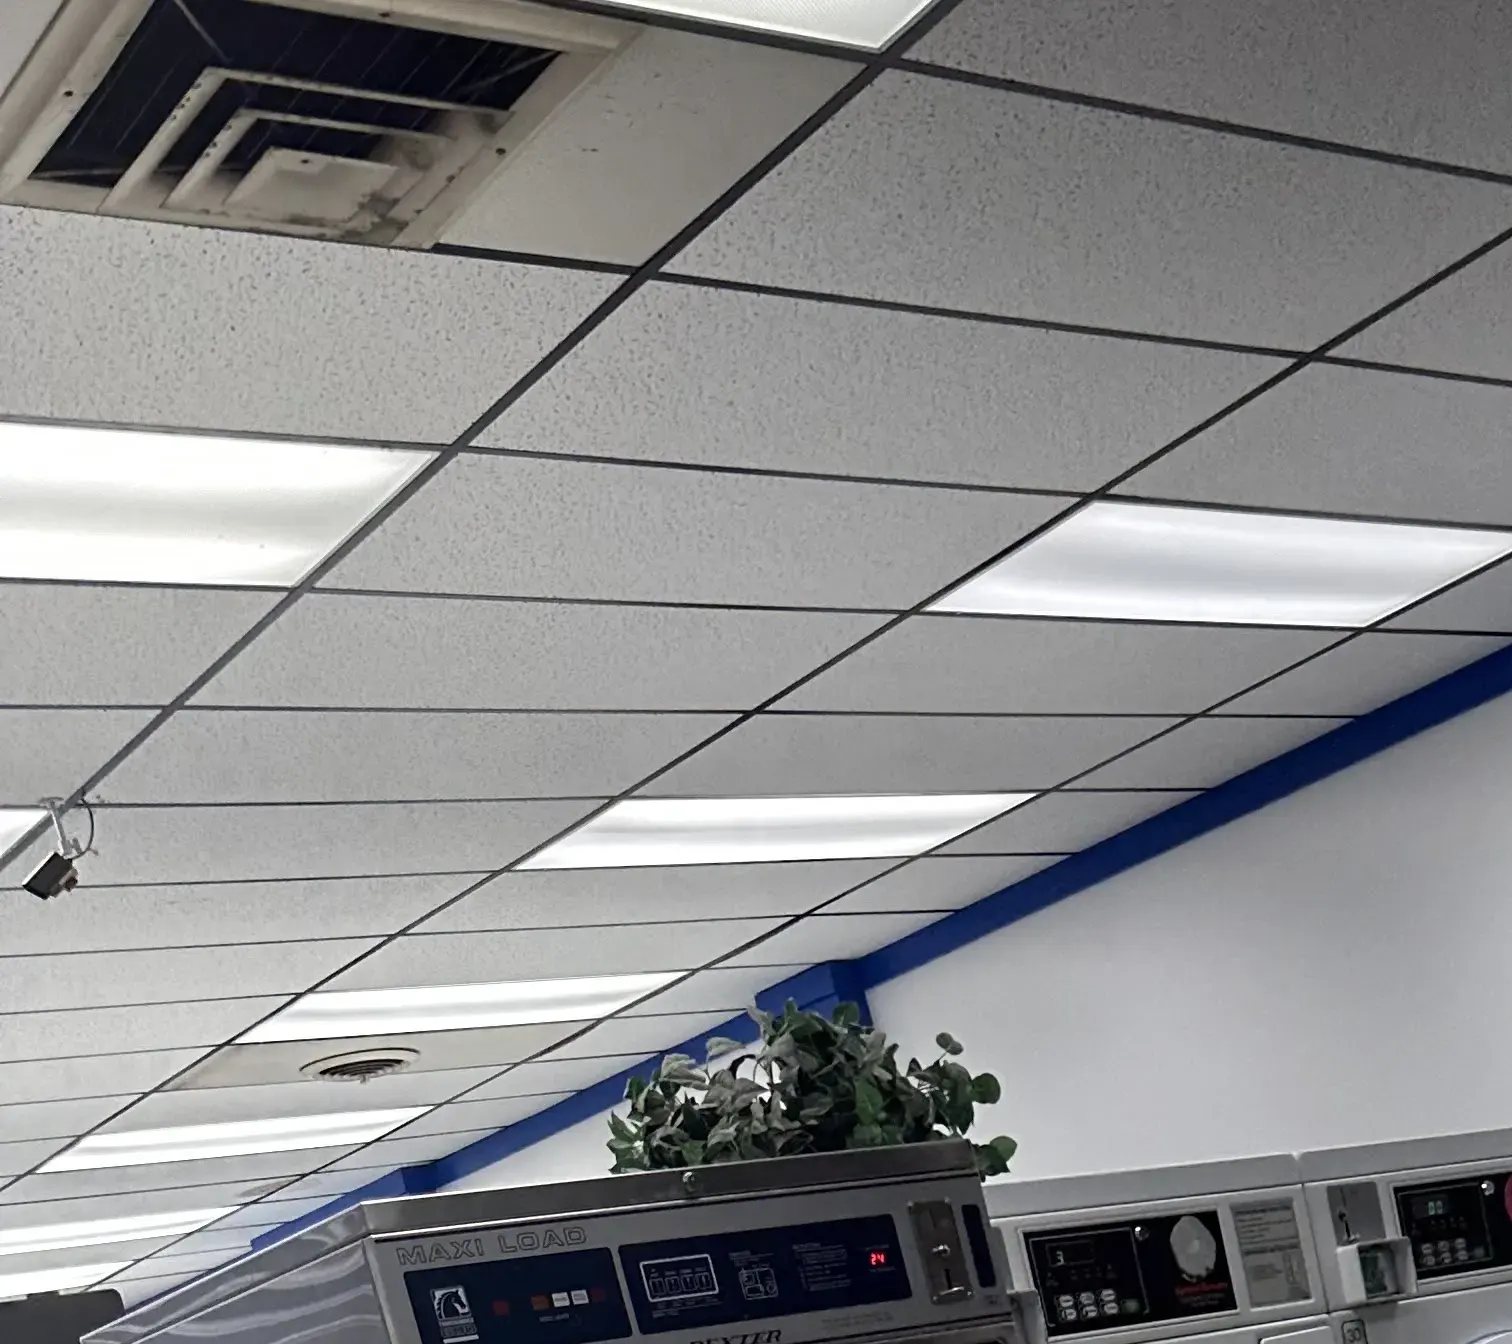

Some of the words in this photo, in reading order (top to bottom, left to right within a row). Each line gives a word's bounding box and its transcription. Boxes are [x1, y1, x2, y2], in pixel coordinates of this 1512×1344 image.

[396, 1238, 486, 1266] MAXI
[497, 1226, 588, 1254] LOAD
[870, 1251, 886, 1267] 24
